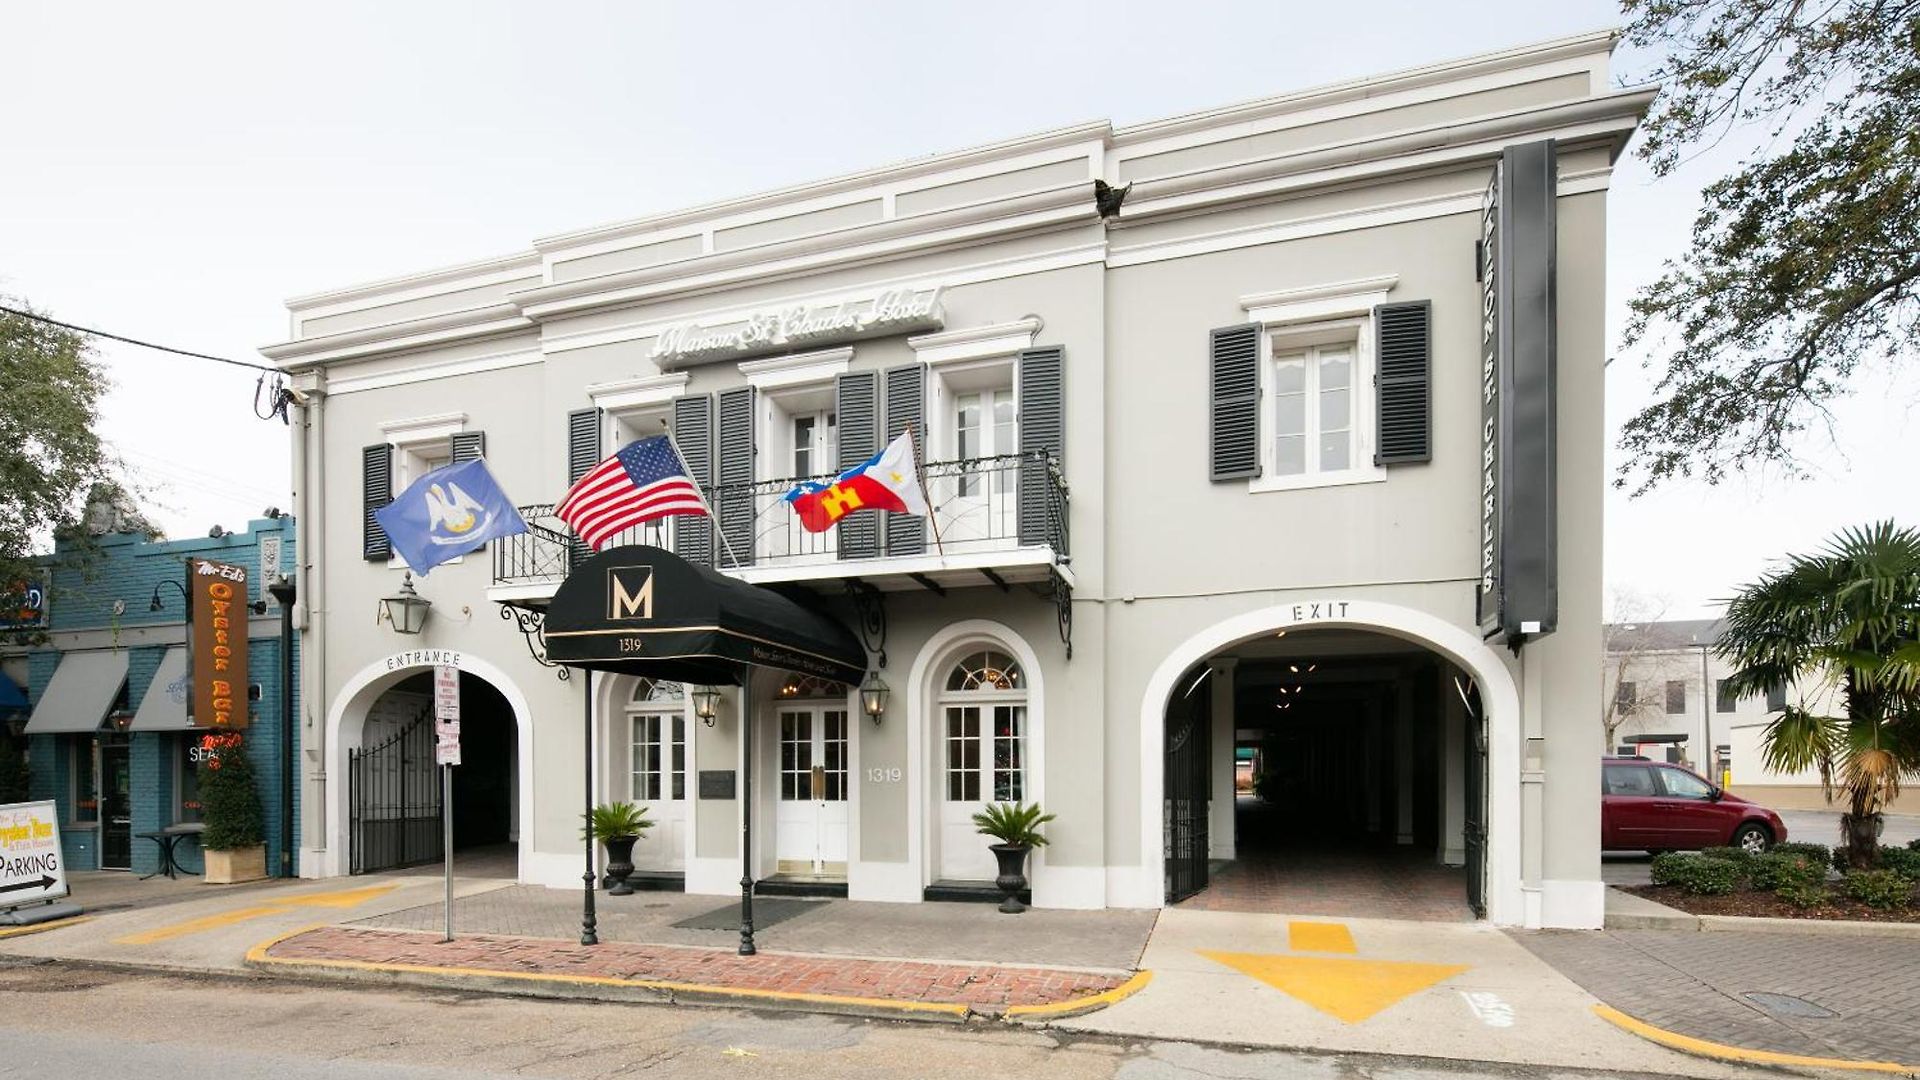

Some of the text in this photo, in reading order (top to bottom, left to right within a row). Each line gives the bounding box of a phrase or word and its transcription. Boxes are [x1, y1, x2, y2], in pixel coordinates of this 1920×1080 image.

[1483, 182, 1496, 345] MAISON
[646, 322, 737, 358] Maison
[776, 303, 856, 336] Charles
[858, 285, 948, 324] Hotel
[1483, 416, 1496, 594] CHARLES
[613, 573, 653, 619] M
[1293, 602, 1349, 621] EXIT
[209, 582, 233, 671] OYSTER
[619, 638, 642, 652] 1319
[387, 650, 460, 669] ENTRANCE
[212, 680, 233, 723] BAR
[868, 767, 902, 782] 1319
